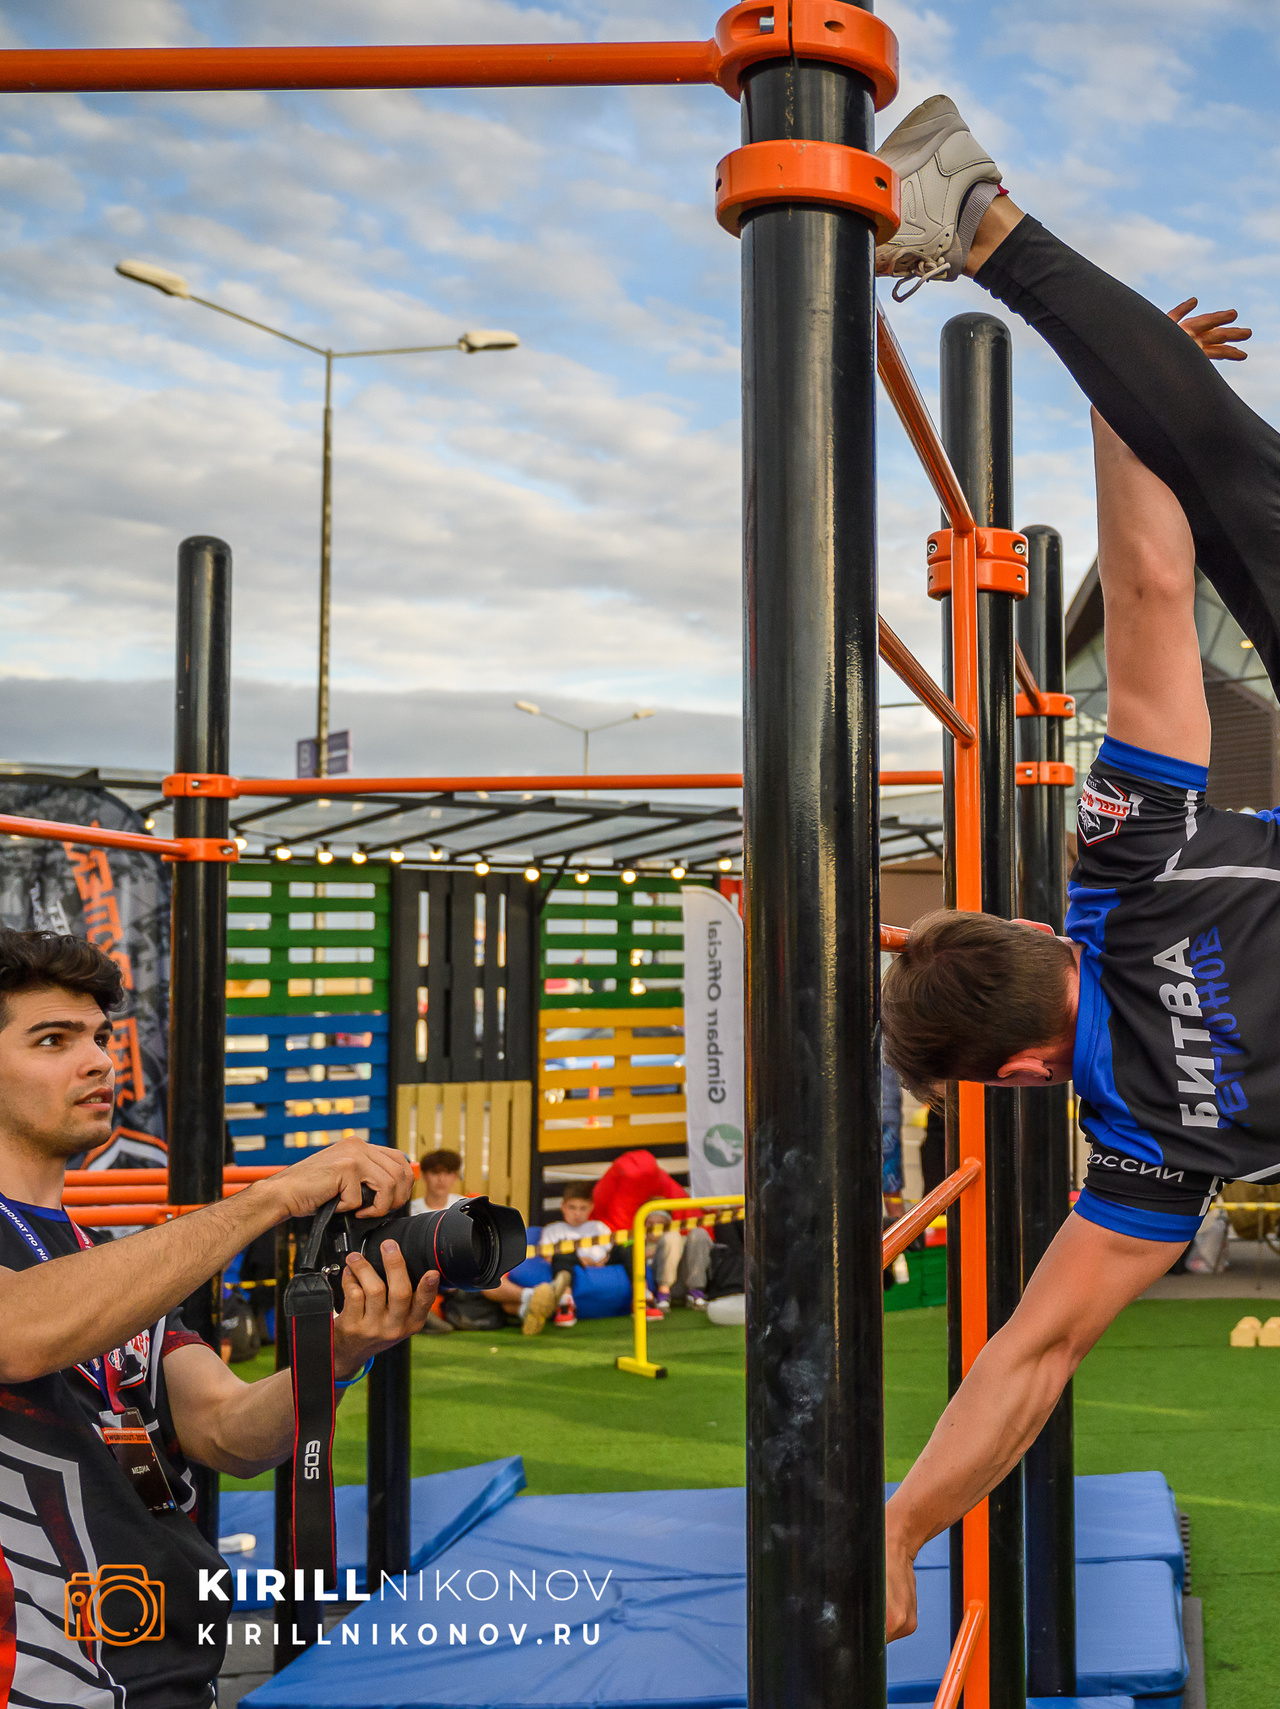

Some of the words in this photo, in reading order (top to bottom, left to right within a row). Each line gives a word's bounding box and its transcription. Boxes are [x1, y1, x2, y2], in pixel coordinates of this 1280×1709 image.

[1095, 797, 1130, 818] STEEL
[1153, 936, 1220, 1129] БИТВА
[1089, 1148, 1185, 1184] ОССИИ
[26, 1233, 39, 1248] ПО
[131, 1464, 151, 1475] МЕДИА
[304, 1440, 321, 1480] EOS
